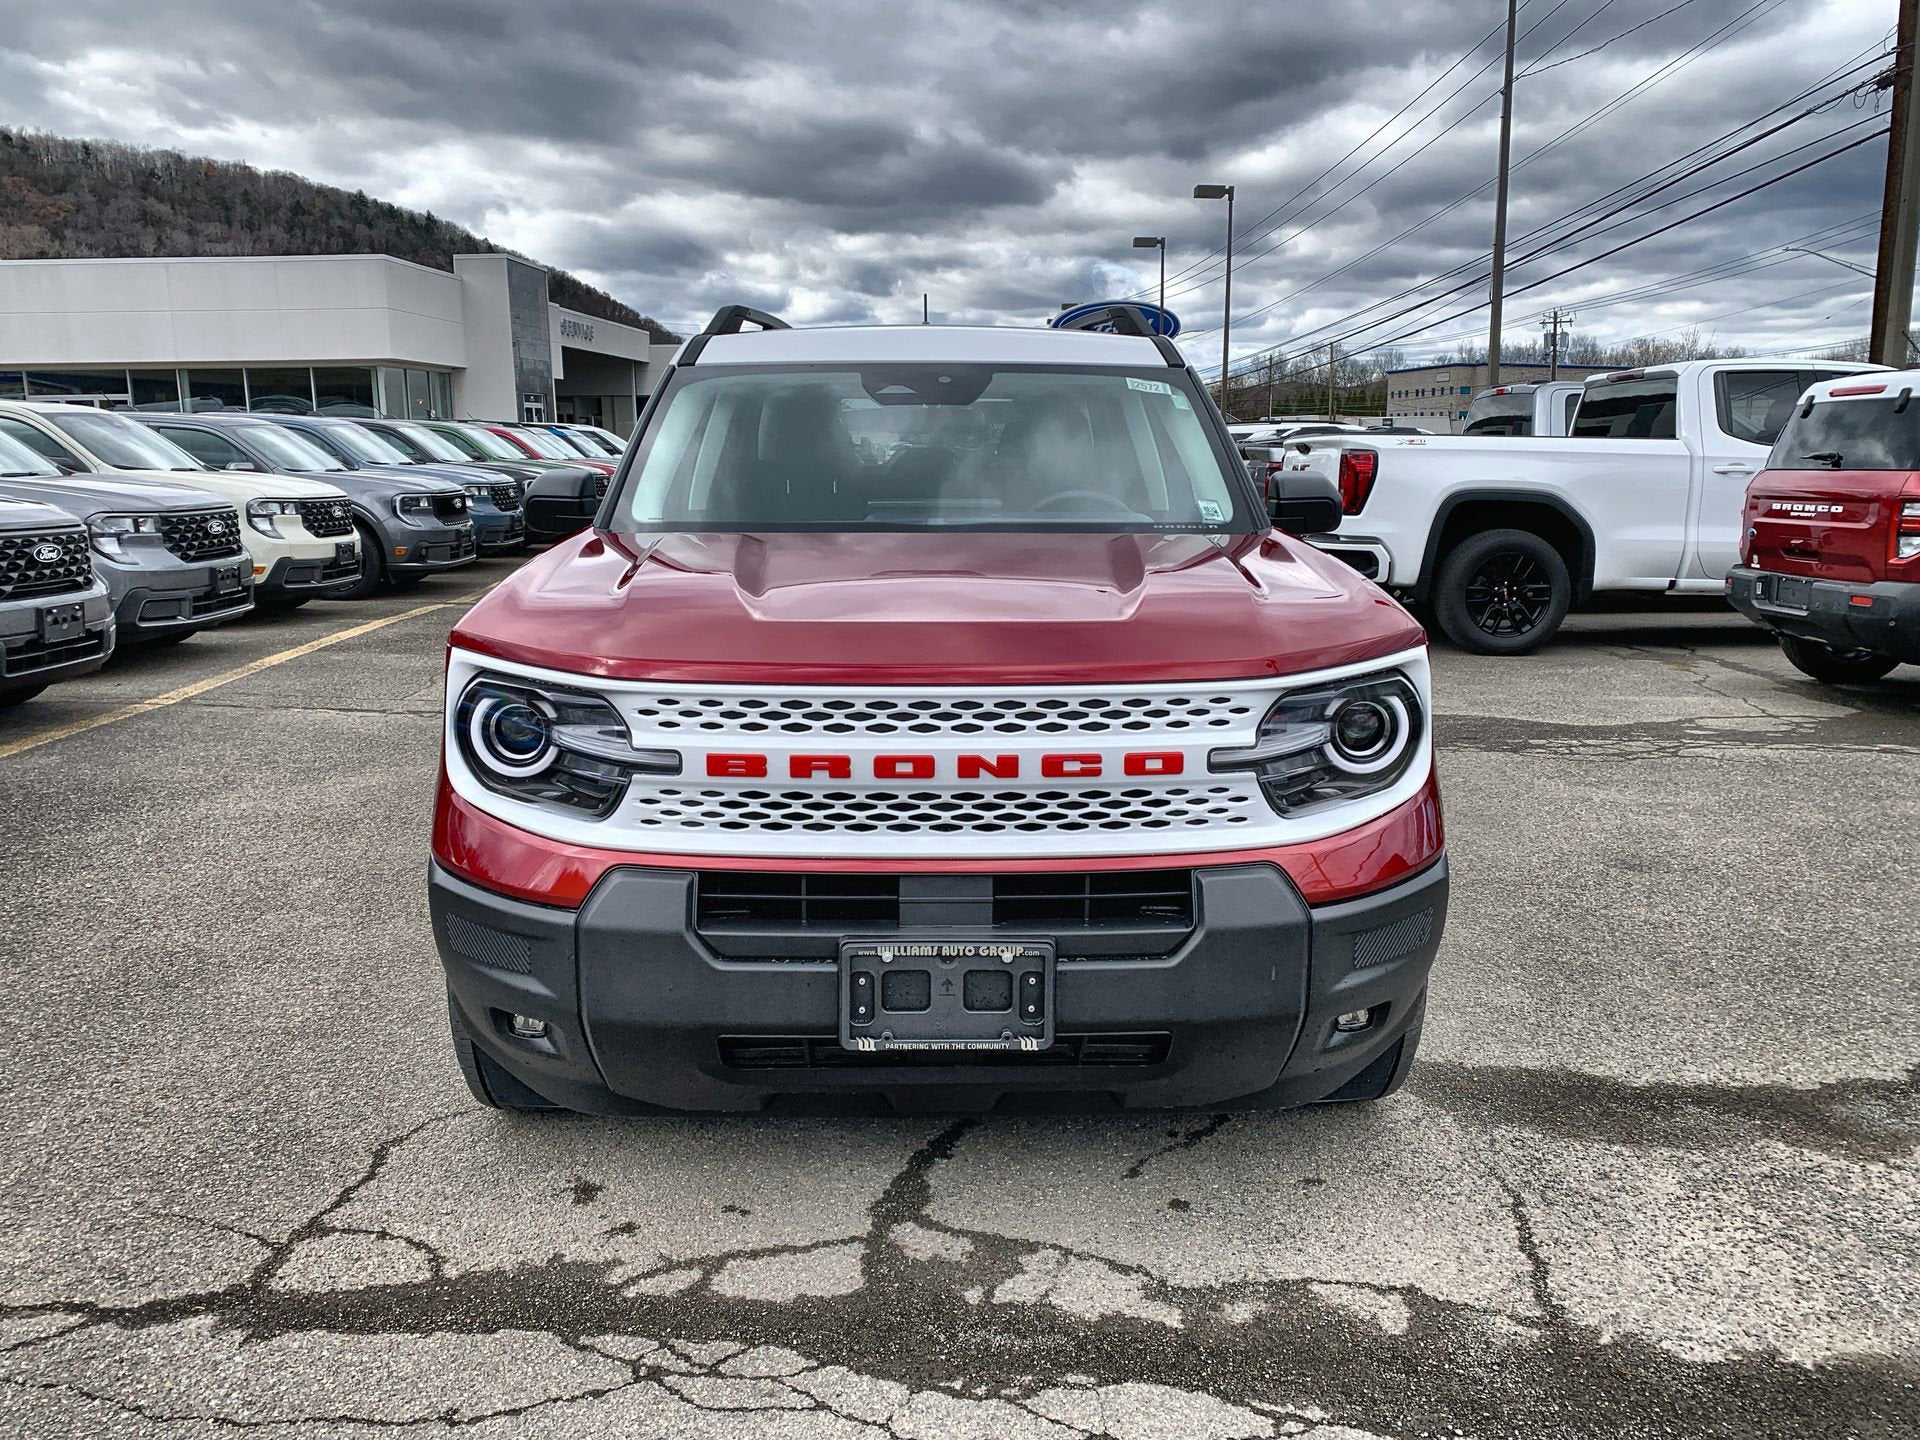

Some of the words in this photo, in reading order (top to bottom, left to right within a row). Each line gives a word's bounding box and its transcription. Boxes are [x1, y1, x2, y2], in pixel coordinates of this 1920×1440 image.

[1771, 503, 1844, 513] BRONCO
[705, 751, 1185, 779] BRONCO
[941, 946, 976, 957] AUTO
